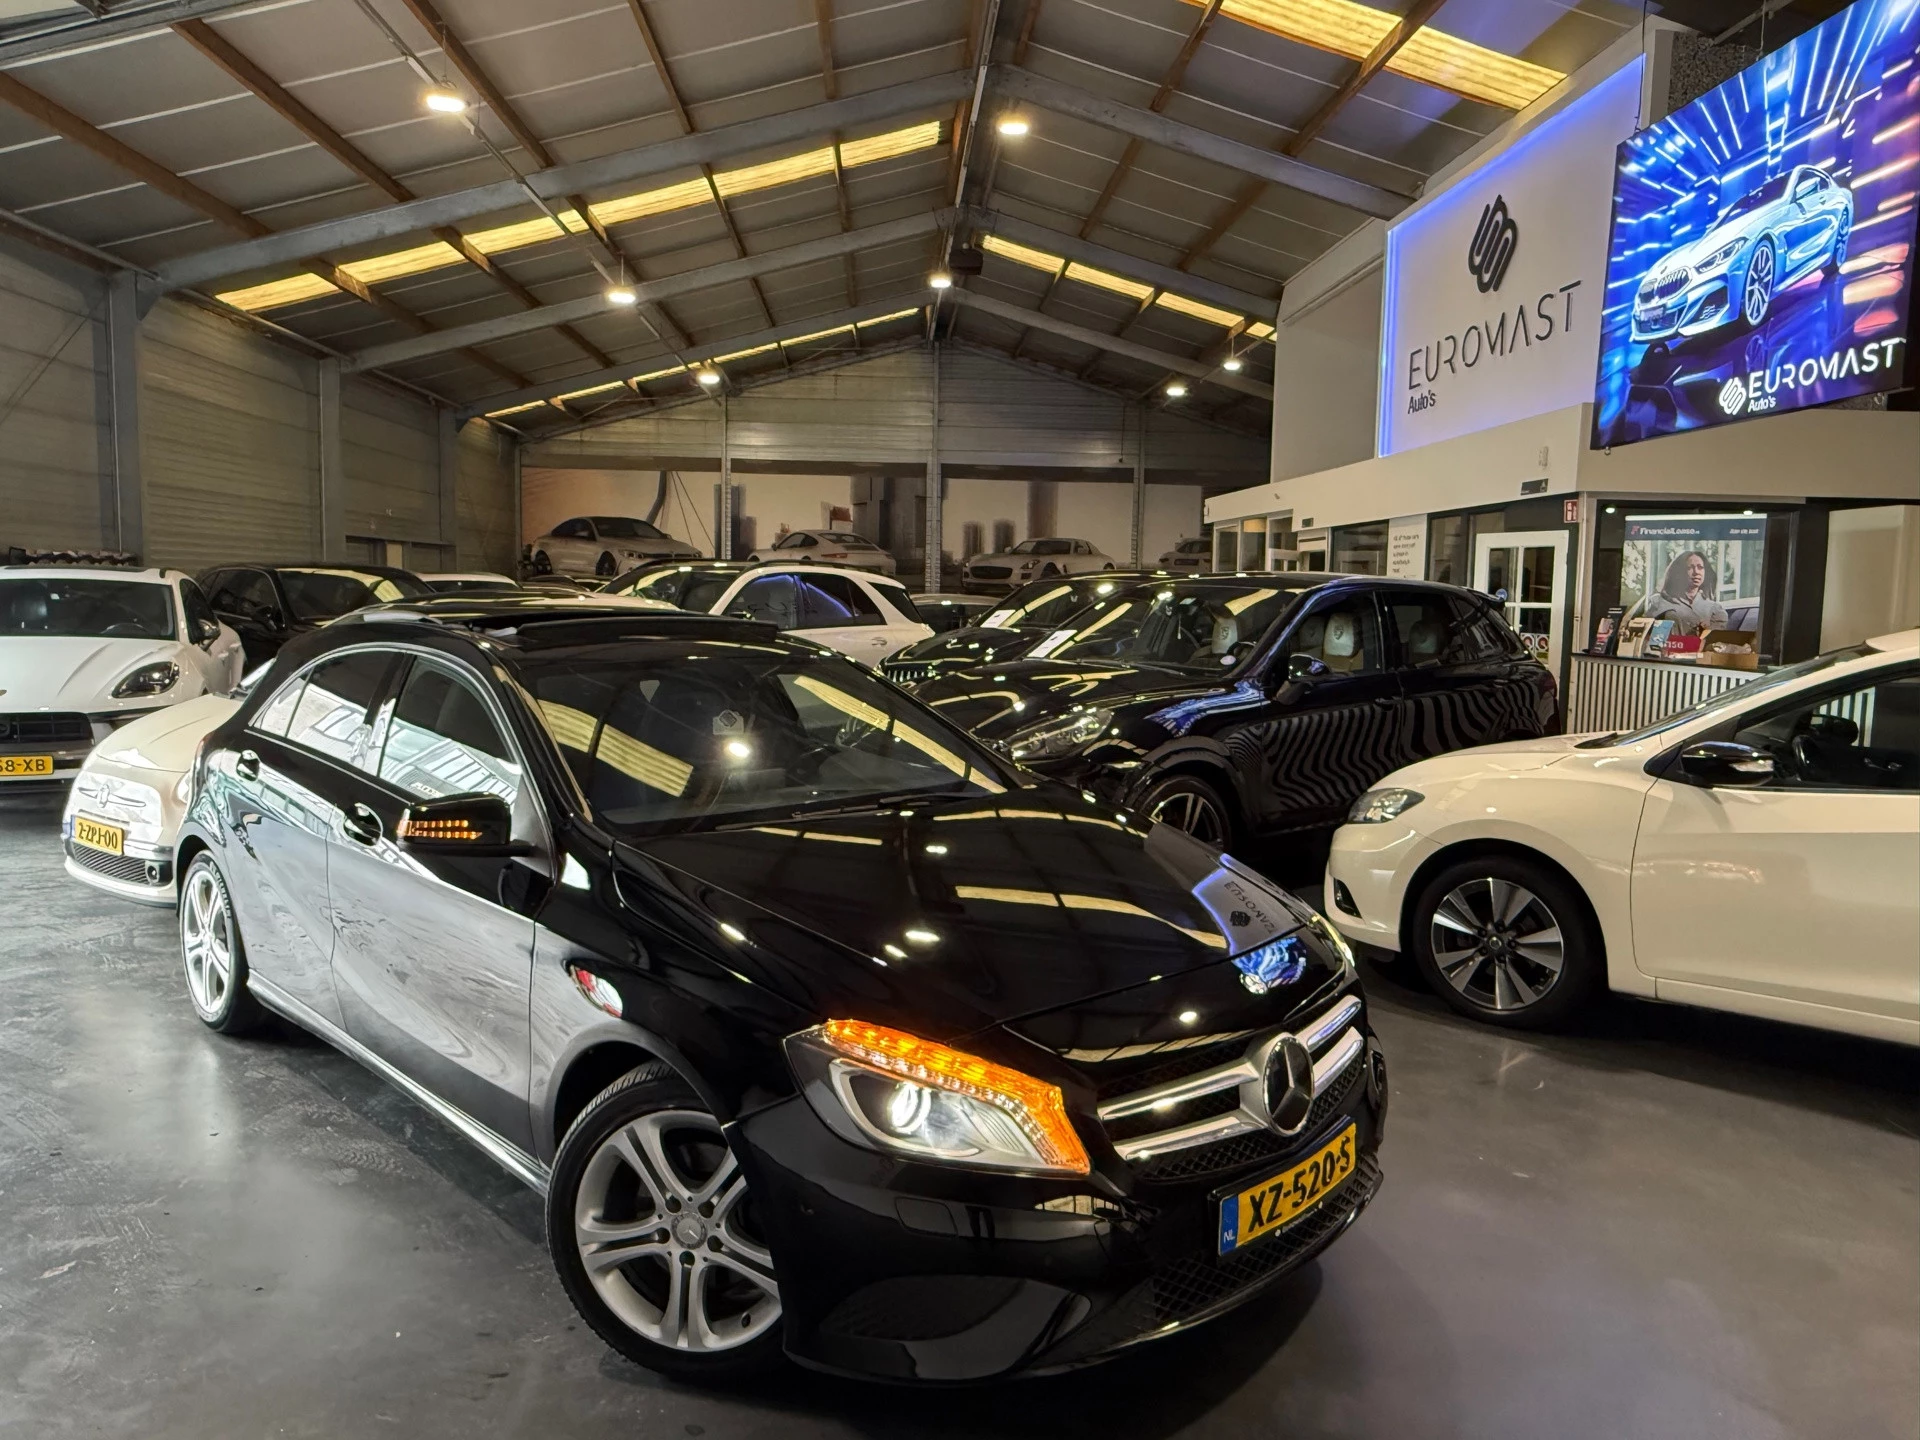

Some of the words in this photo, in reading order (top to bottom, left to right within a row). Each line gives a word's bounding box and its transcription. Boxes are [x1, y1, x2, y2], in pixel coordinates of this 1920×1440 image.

[1408, 280, 1582, 391] EUROMAST
[1748, 337, 1905, 399] EUROMAST
[1407, 389, 1437, 414] Auto's
[1747, 396, 1777, 413] Auto's
[1247, 1135, 1352, 1233] XZ-520-S
[1223, 1230, 1236, 1244] NL
